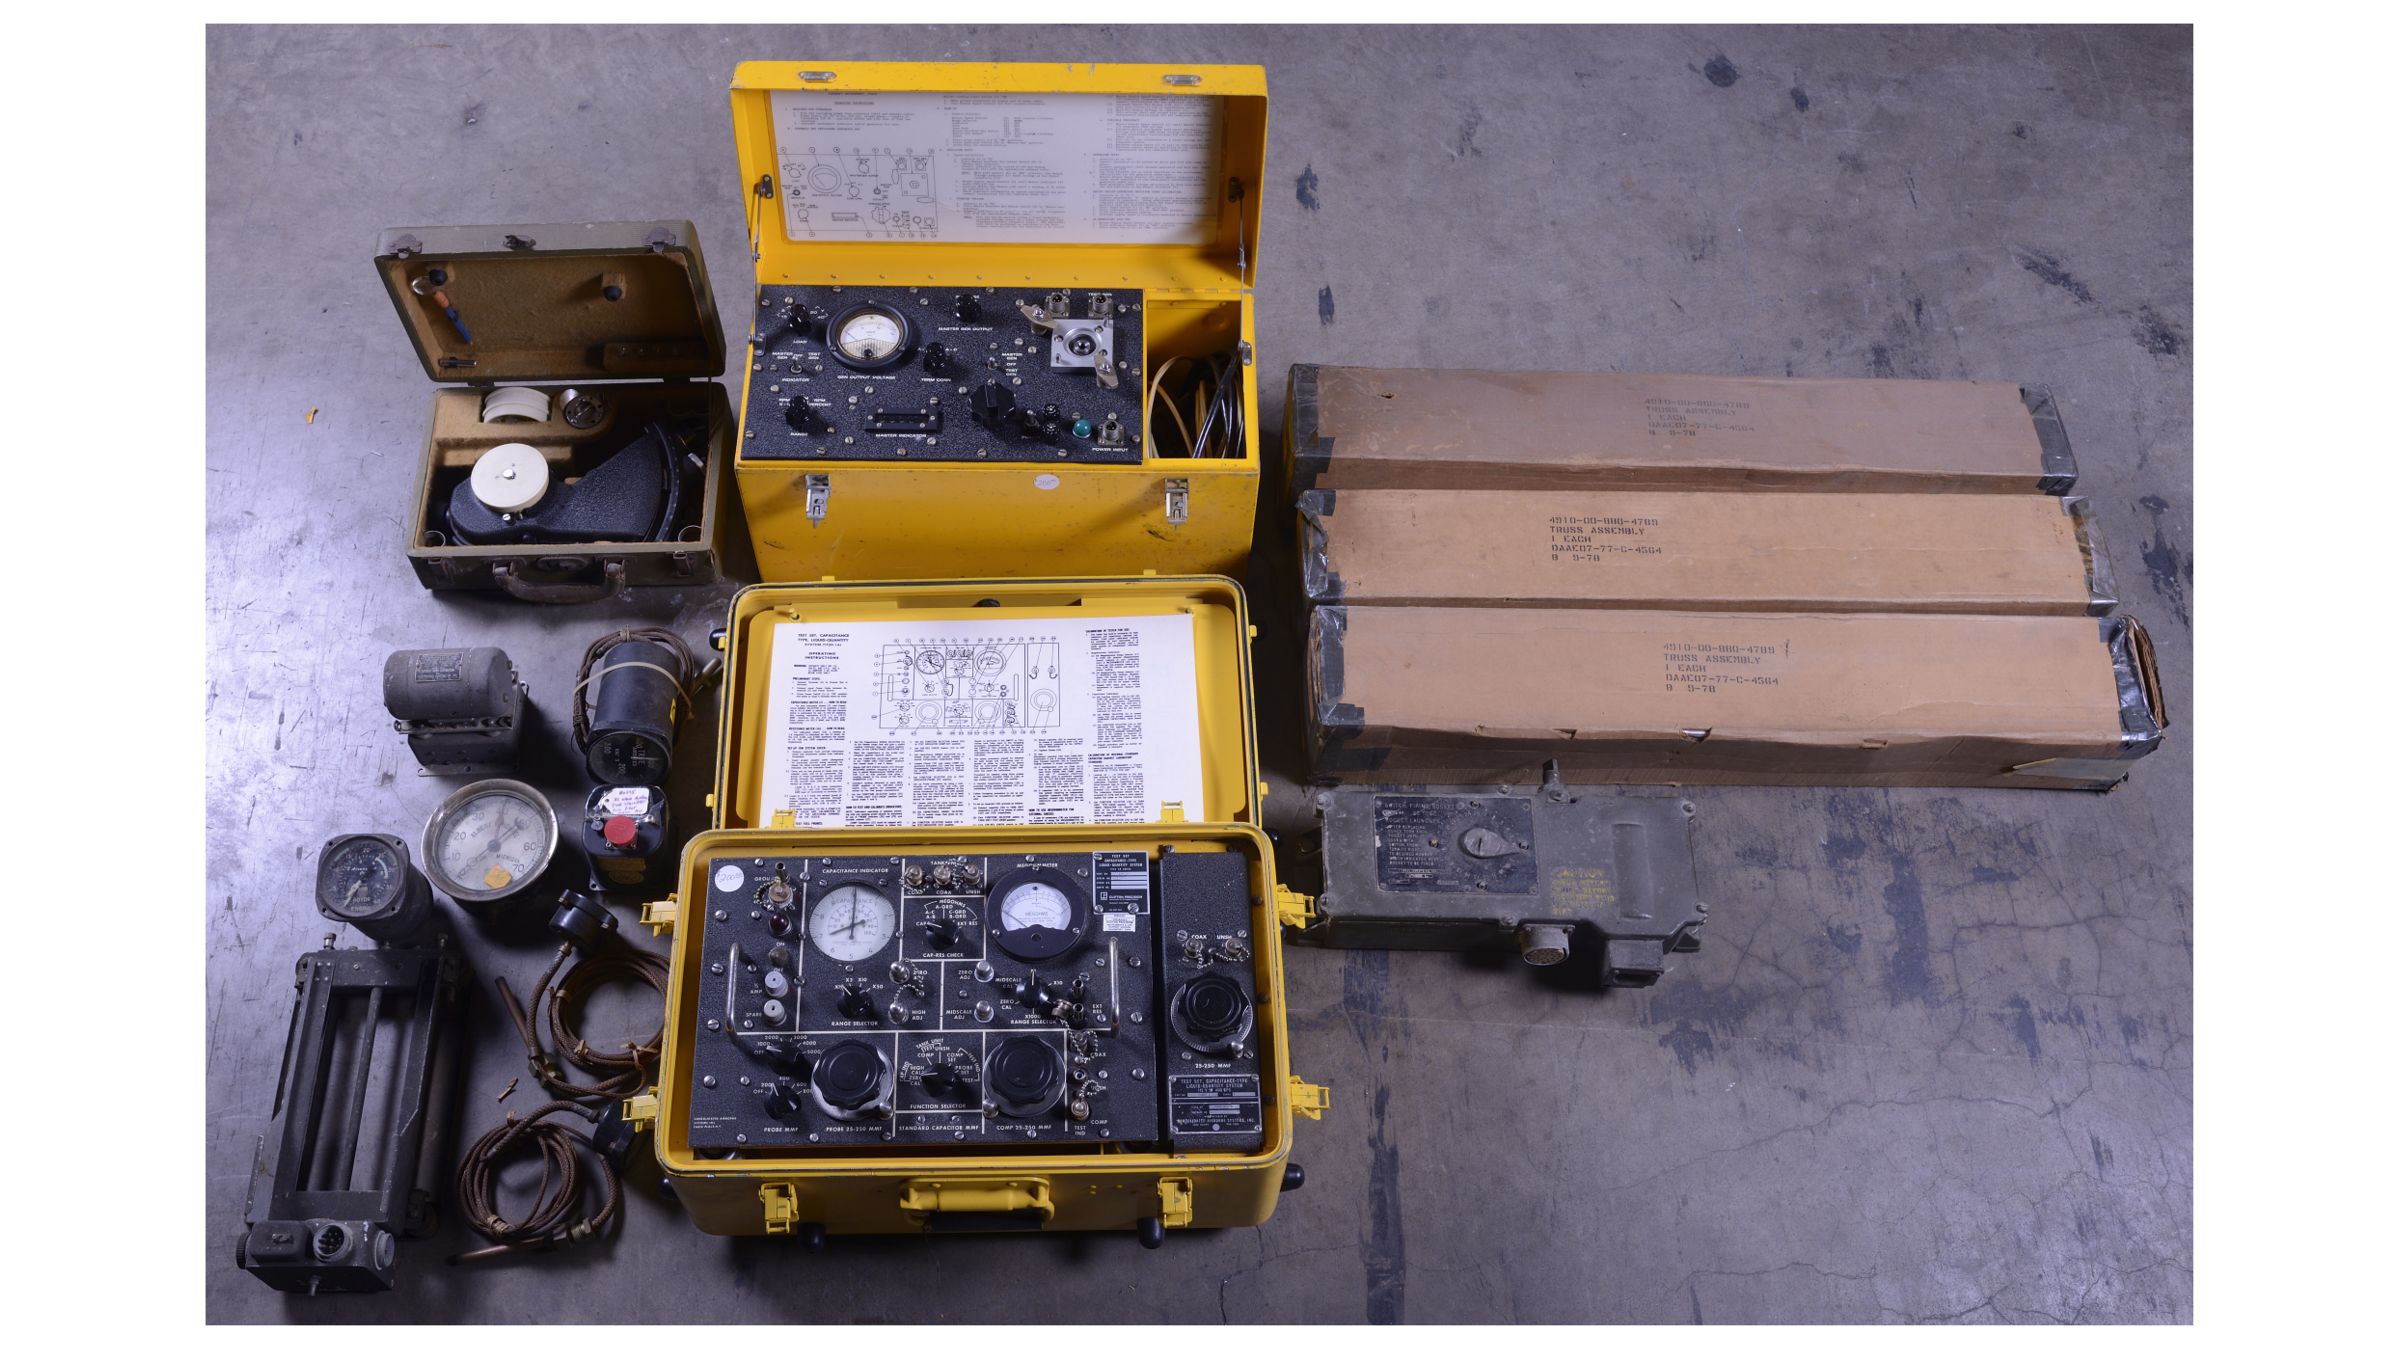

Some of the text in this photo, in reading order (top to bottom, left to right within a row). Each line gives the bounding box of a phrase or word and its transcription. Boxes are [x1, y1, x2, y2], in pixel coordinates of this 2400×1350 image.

[1550, 525, 1645, 536] TRUSS ASSEMBLY
[1563, 535, 1592, 543] EACH
[1664, 653, 1761, 665] TRUSS ASSEMBLY
[1678, 664, 1707, 673] EACH
[454, 831, 467, 841] 20
[523, 841, 537, 851] 60
[512, 863, 525, 873] 70
